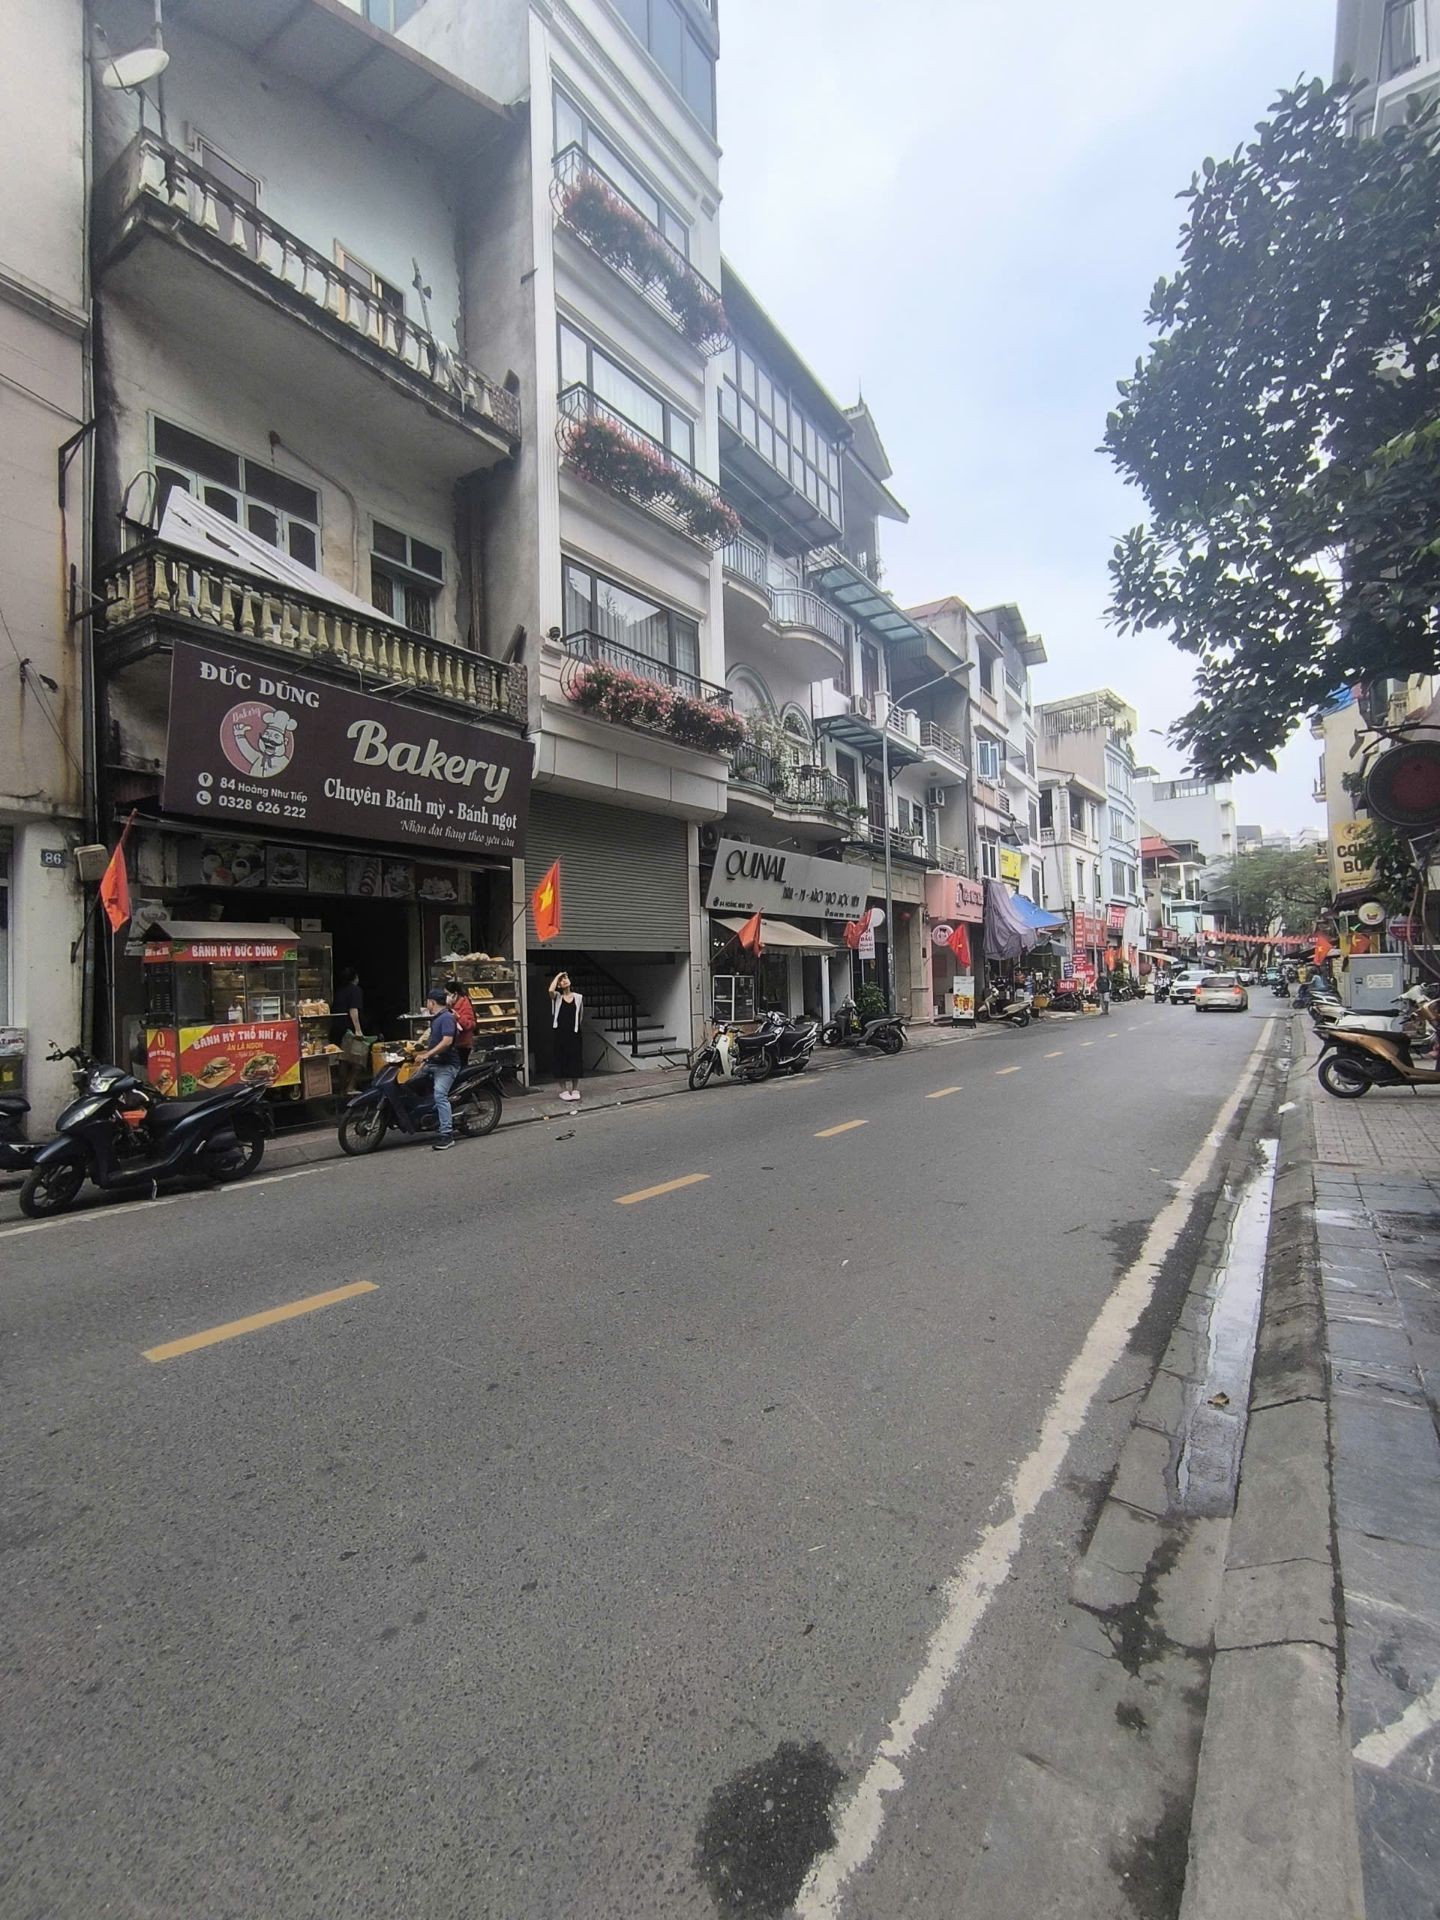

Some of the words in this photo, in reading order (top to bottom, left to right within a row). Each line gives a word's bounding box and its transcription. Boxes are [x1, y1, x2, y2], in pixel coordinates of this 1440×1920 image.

[200, 661, 251, 690] ĐỨC
[258, 677, 320, 708] DŨNG
[347, 719, 511, 804] Bakery
[218, 795, 252, 810] 0328
[256, 801, 280, 814] 626
[283, 805, 307, 818] 222
[220, 777, 236, 790] 84
[238, 782, 269, 798] Hoàng
[271, 788, 289, 799] Như
[290, 791, 308, 803] Tiếp
[324, 778, 381, 806] Chuyên
[385, 789, 422, 813] Bánh
[426, 798, 446, 820] mỳ
[457, 802, 488, 824] Bánh
[492, 813, 517, 831] ngọt
[45, 852, 62, 865] 86
